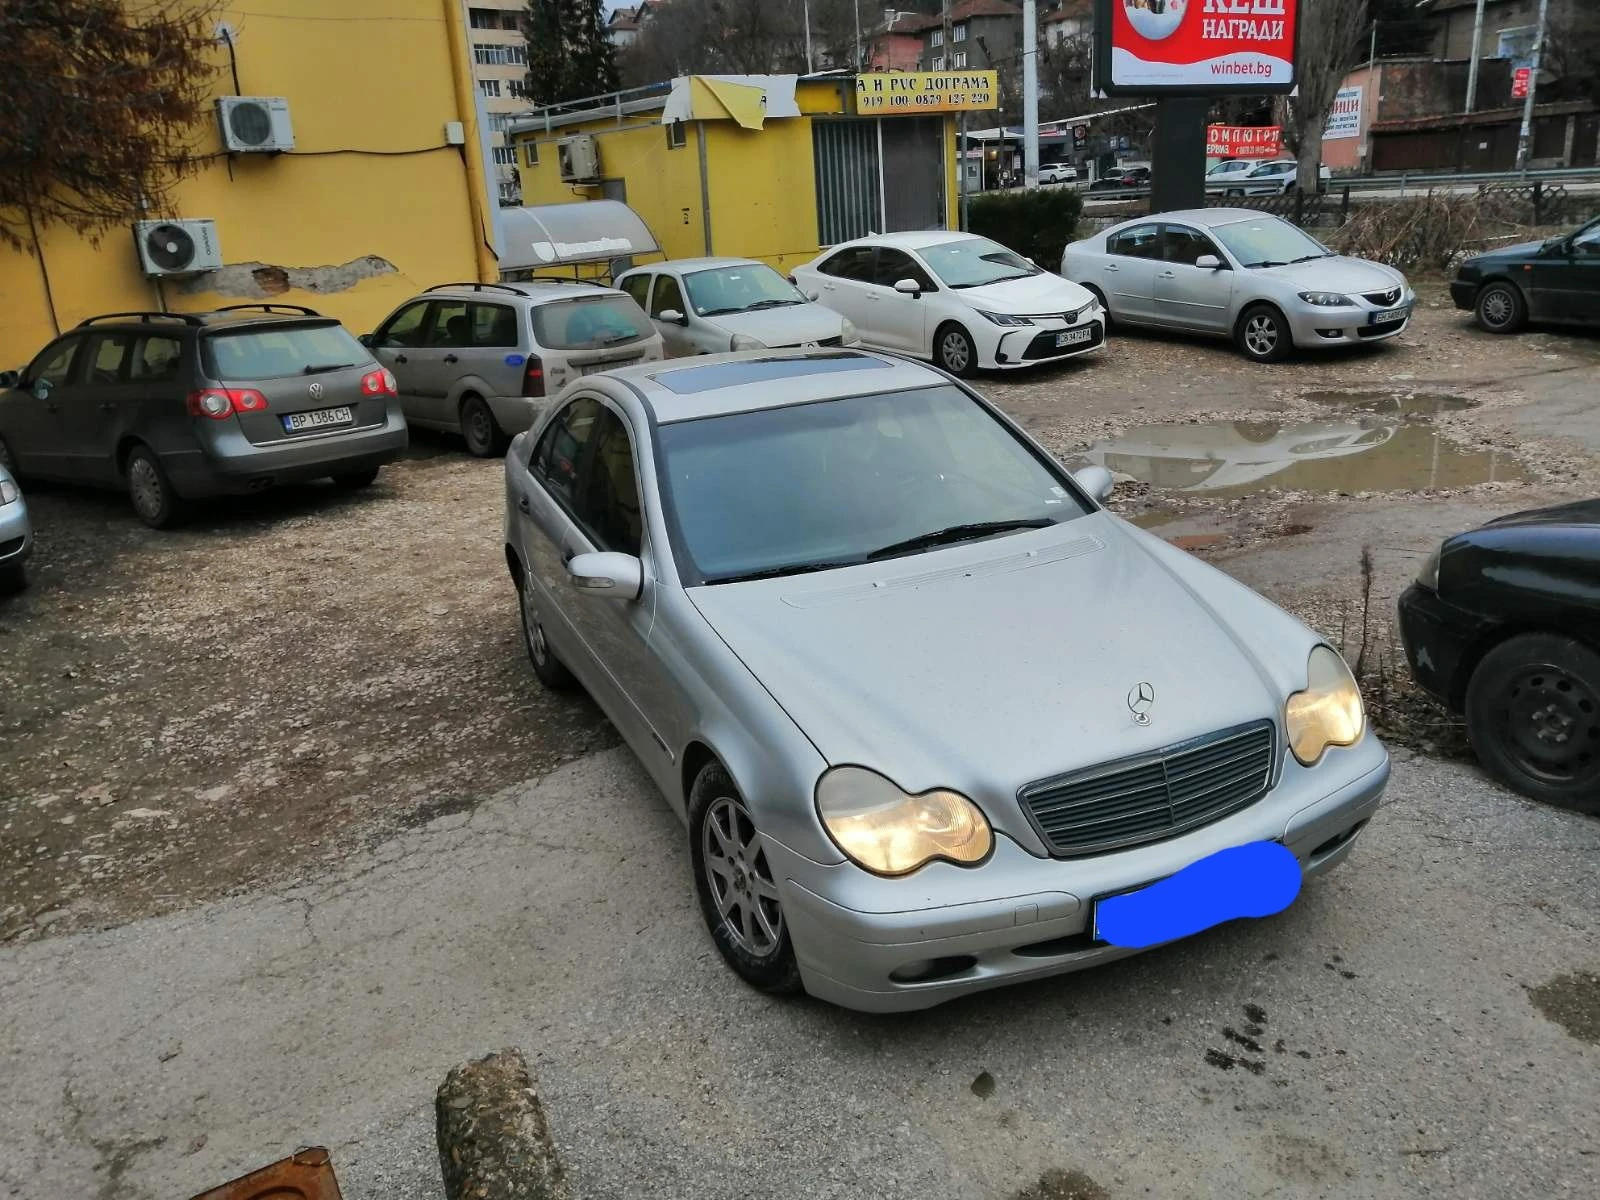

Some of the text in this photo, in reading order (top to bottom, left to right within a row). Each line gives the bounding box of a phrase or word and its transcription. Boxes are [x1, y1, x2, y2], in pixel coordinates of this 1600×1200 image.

[1202, 19, 1284, 40] НАГРАДИ
[1210, 61, 1272, 77] winbet.bg
[891, 78, 917, 91] PVC
[925, 76, 989, 90] ДОГРАМА
[915, 94, 942, 106] 0879
[971, 93, 989, 103] 220
[1207, 143, 1230, 154] ЕРВИЗ
[292, 408, 350, 428] BP 1386 CH
